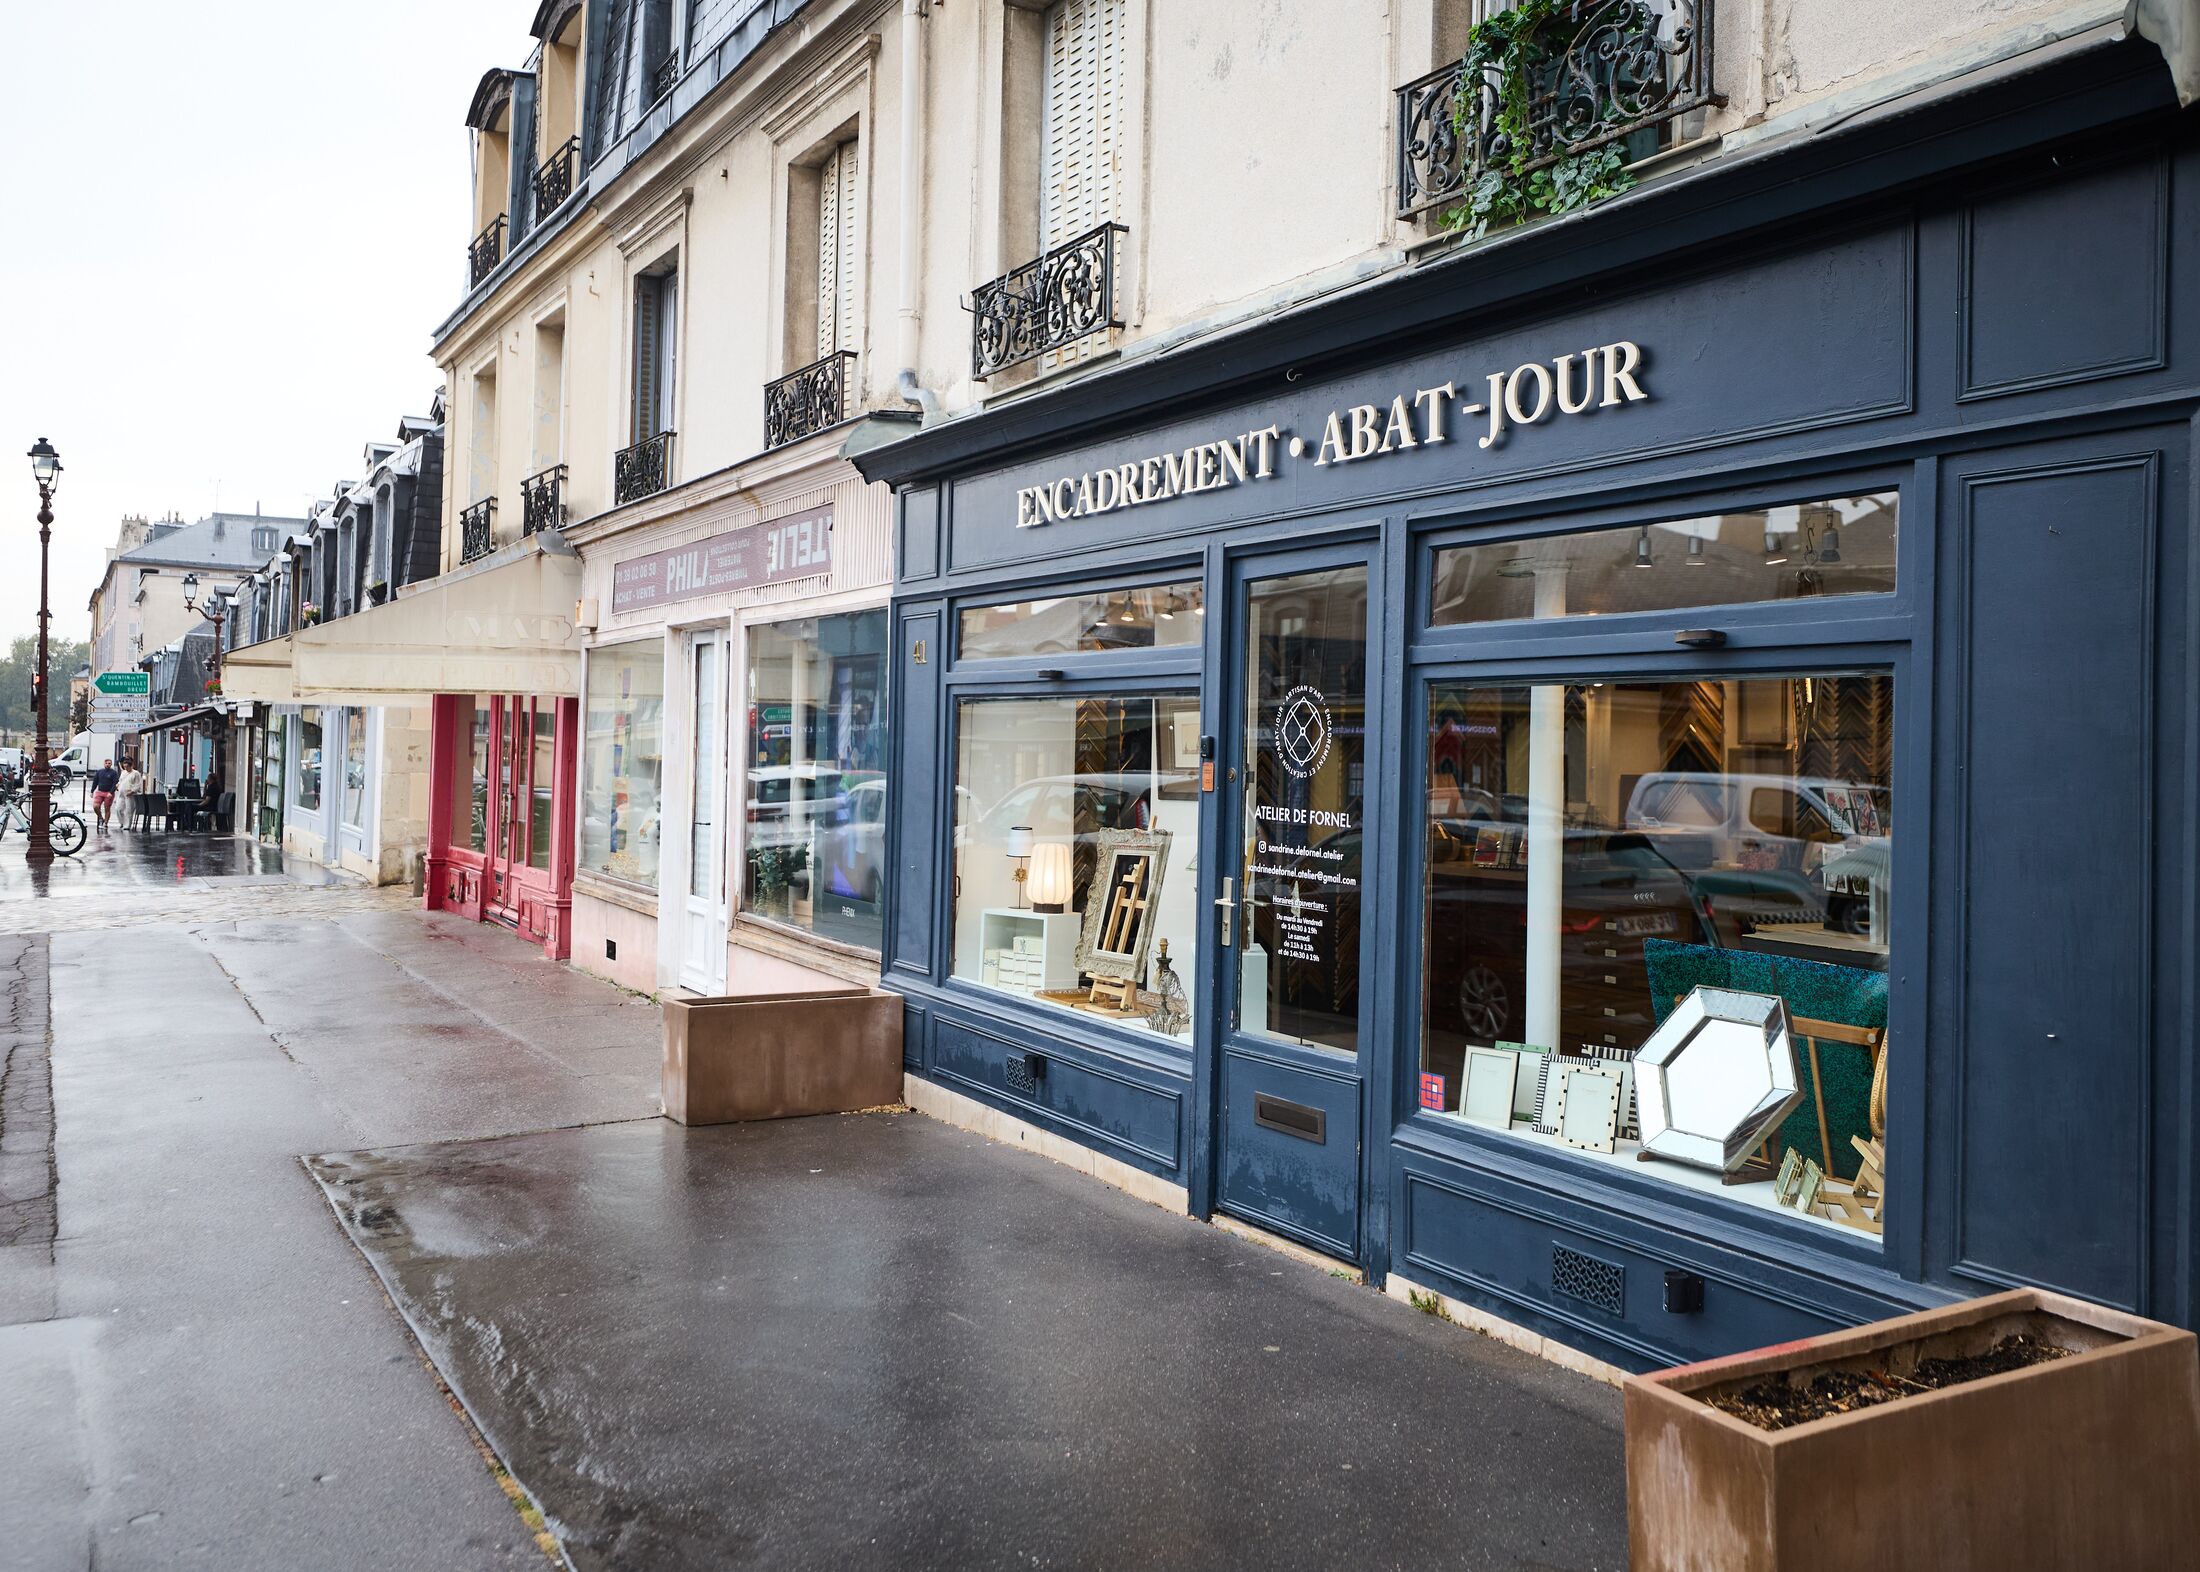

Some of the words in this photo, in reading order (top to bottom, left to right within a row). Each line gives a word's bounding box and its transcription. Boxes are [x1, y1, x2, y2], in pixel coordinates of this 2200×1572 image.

[1016, 423, 1280, 529] ENCADREMENT
[1313, 340, 1649, 466] ABAT-JOUR
[636, 585, 656, 600] VENTE
[912, 639, 928, 665] 41
[1285, 684, 1307, 702] ARTISAN
[1308, 685, 1324, 702] D'ART
[1274, 705, 1285, 759] D'ABAT-JOUR
[1316, 708, 1333, 771] ENCADREMENT
[1309, 765, 1317, 777] ET
[1254, 804, 1291, 822] ATELIER
[1293, 808, 1307, 824] DE
[1309, 810, 1352, 828] FORNEL
[1268, 842, 1344, 861] sandrine.defornel.atelier
[1247, 862, 1357, 886] sandrinedefornel.atelier@gmail.com
[1272, 895, 1294, 906] Horaires
[1276, 912, 1283, 920] Du
[1283, 914, 1296, 923] mardi
[1302, 917, 1323, 927] Vendredi
[1280, 922, 1287, 930] de
[1288, 923, 1303, 932] 14h30
[1308, 926, 1318, 934] 19h
[1293, 934, 1311, 942] samedi
[1290, 950, 1305, 959] 14h30
[1310, 954, 1320, 962] 19h
